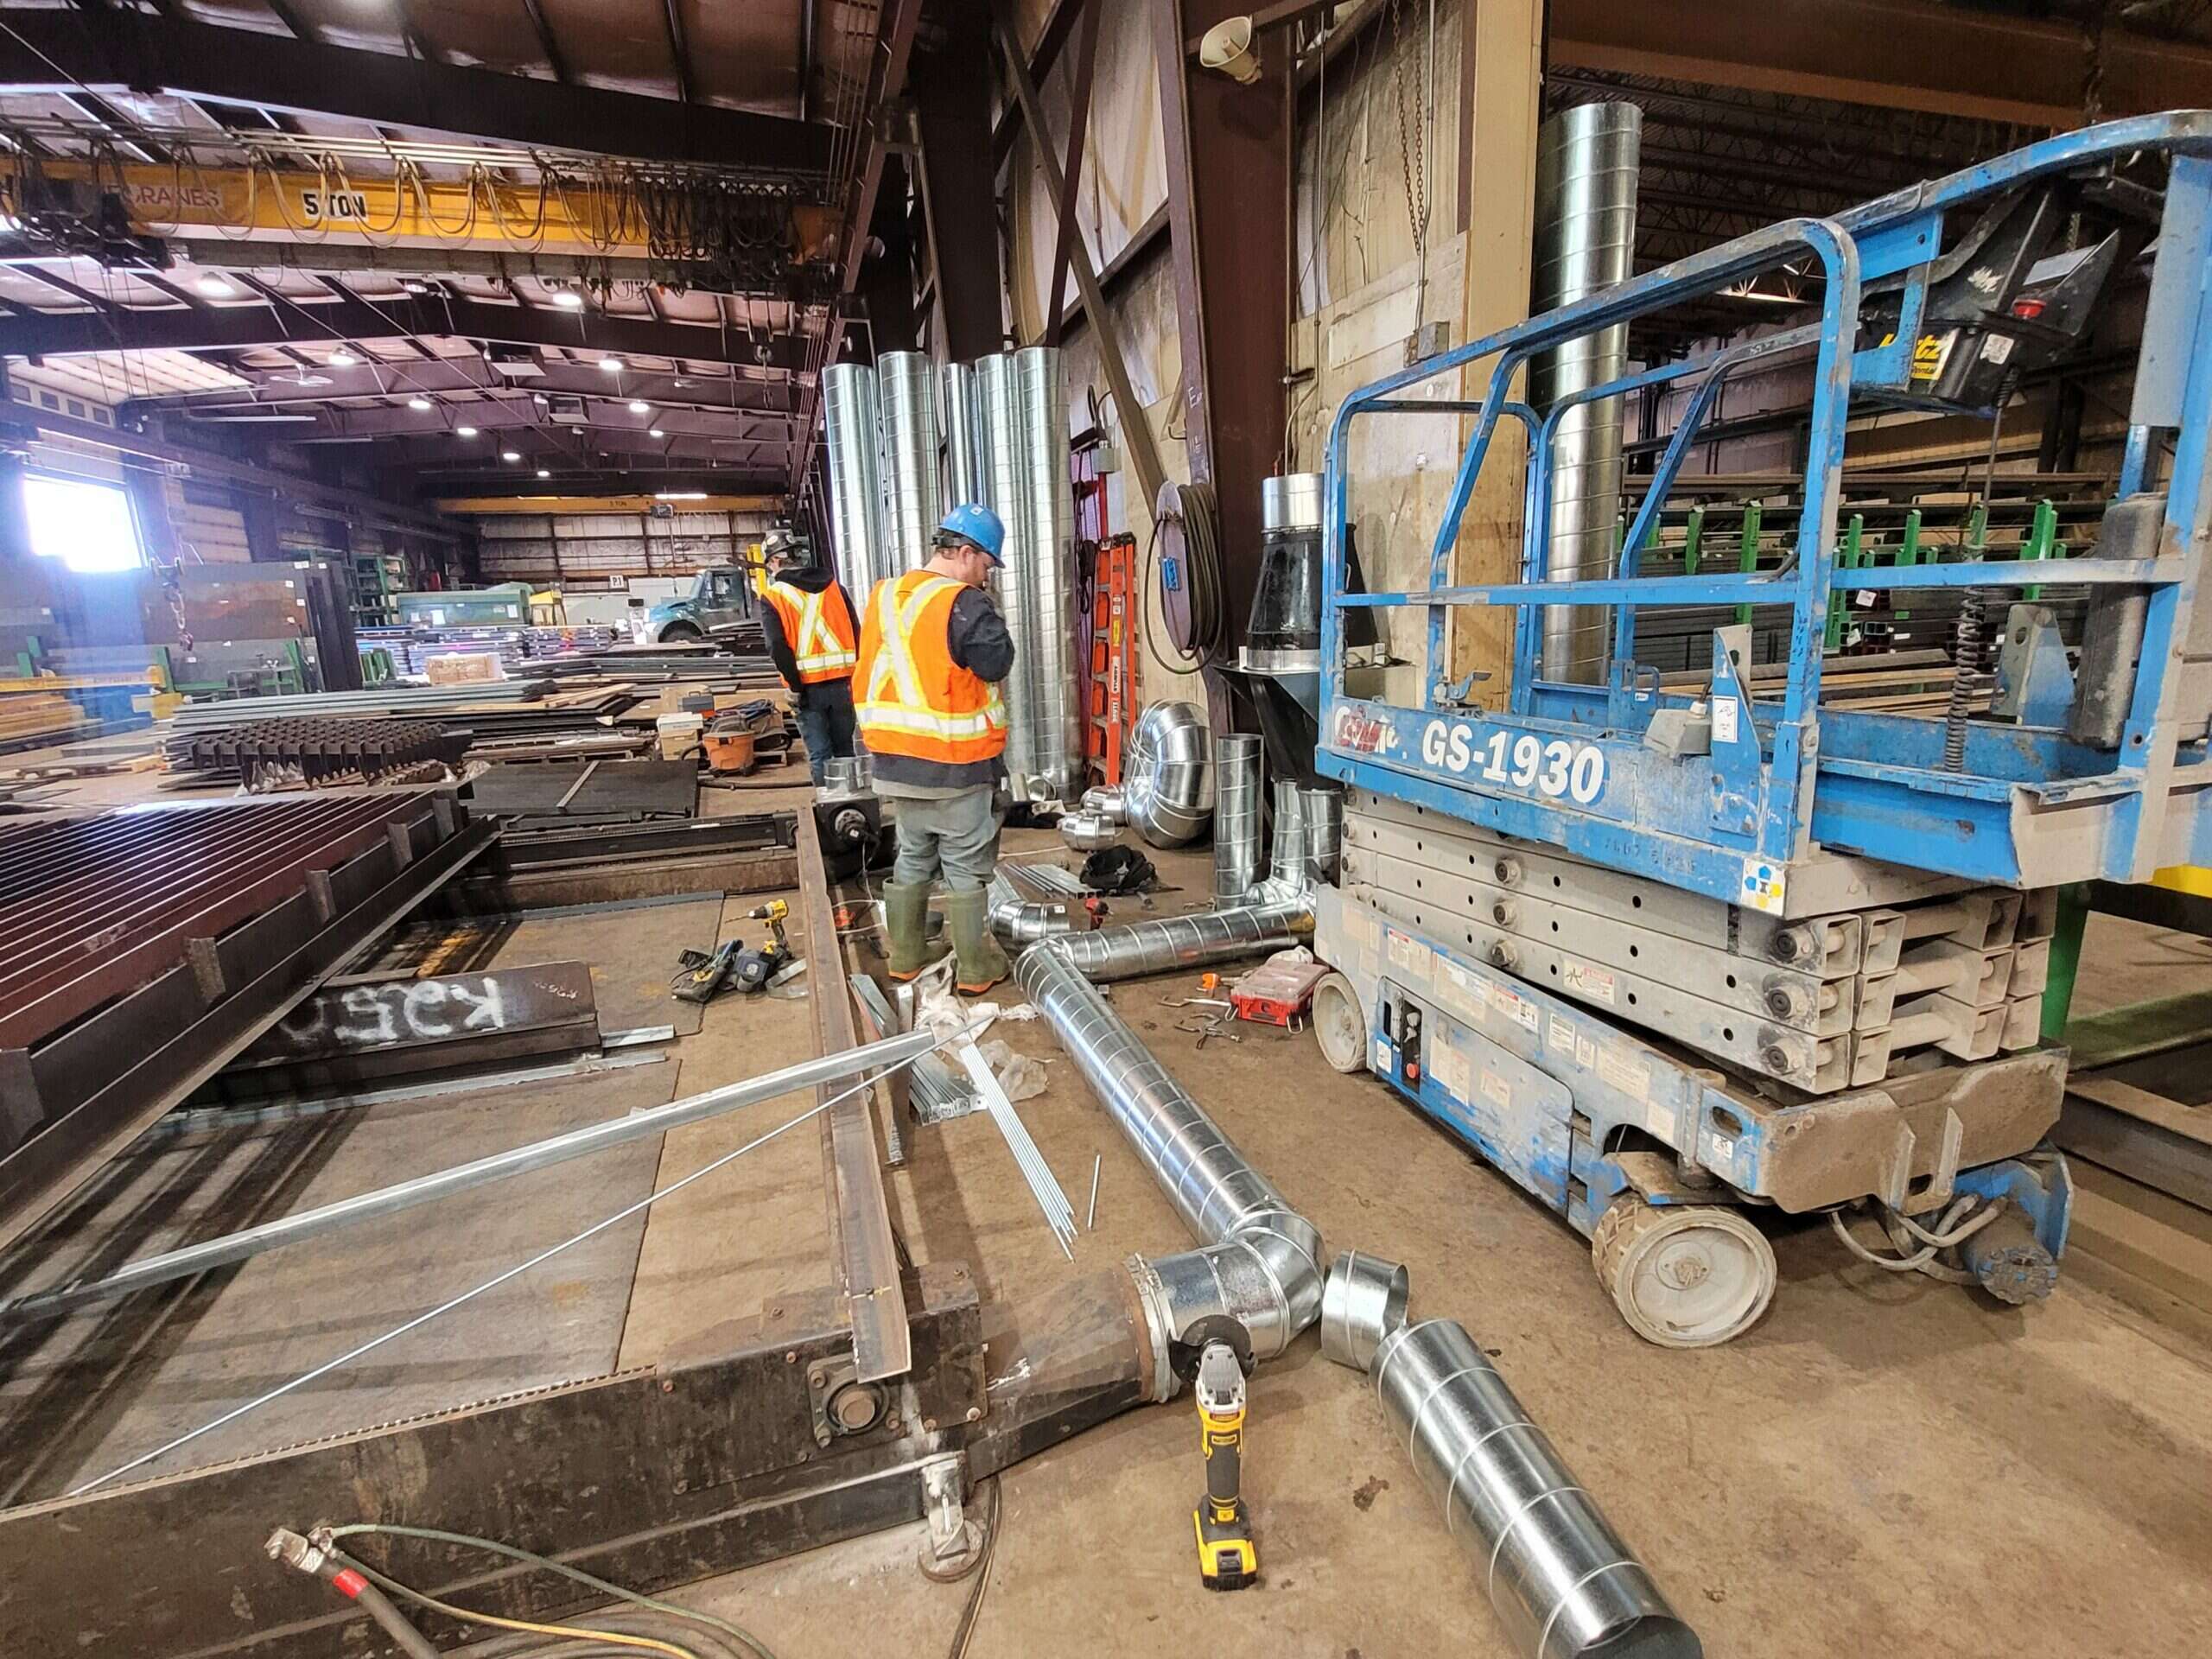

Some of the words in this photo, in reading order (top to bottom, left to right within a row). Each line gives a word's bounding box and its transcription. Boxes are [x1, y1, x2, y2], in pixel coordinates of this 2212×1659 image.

[303, 194, 318, 215] 5
[329, 194, 366, 217] TON
[1422, 719, 1605, 803] GS-1930
